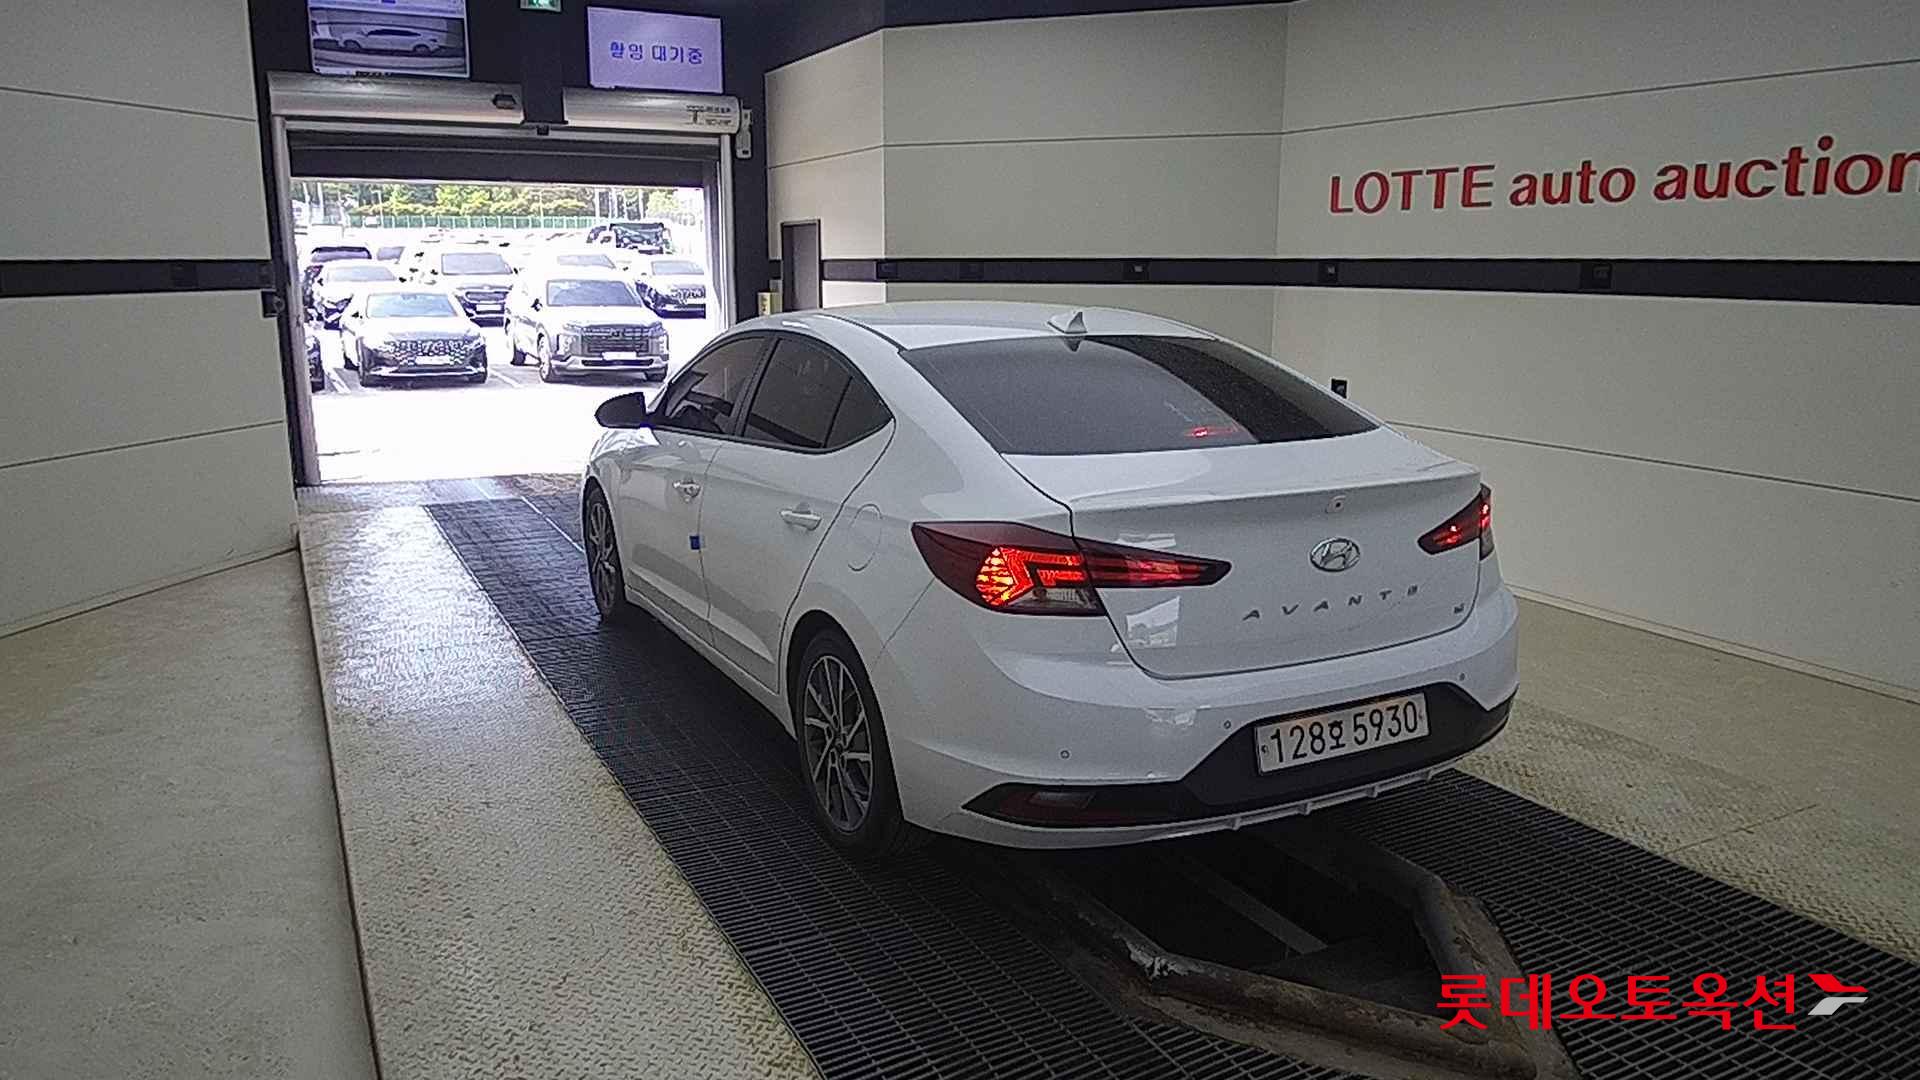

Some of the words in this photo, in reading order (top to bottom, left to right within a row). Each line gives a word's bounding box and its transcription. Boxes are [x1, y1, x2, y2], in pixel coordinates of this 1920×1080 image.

[652, 44, 702, 65] 대기중
[1330, 164, 1496, 214] LOTTE
[1510, 159, 1636, 206] auto
[1353, 701, 1418, 746] 5930
